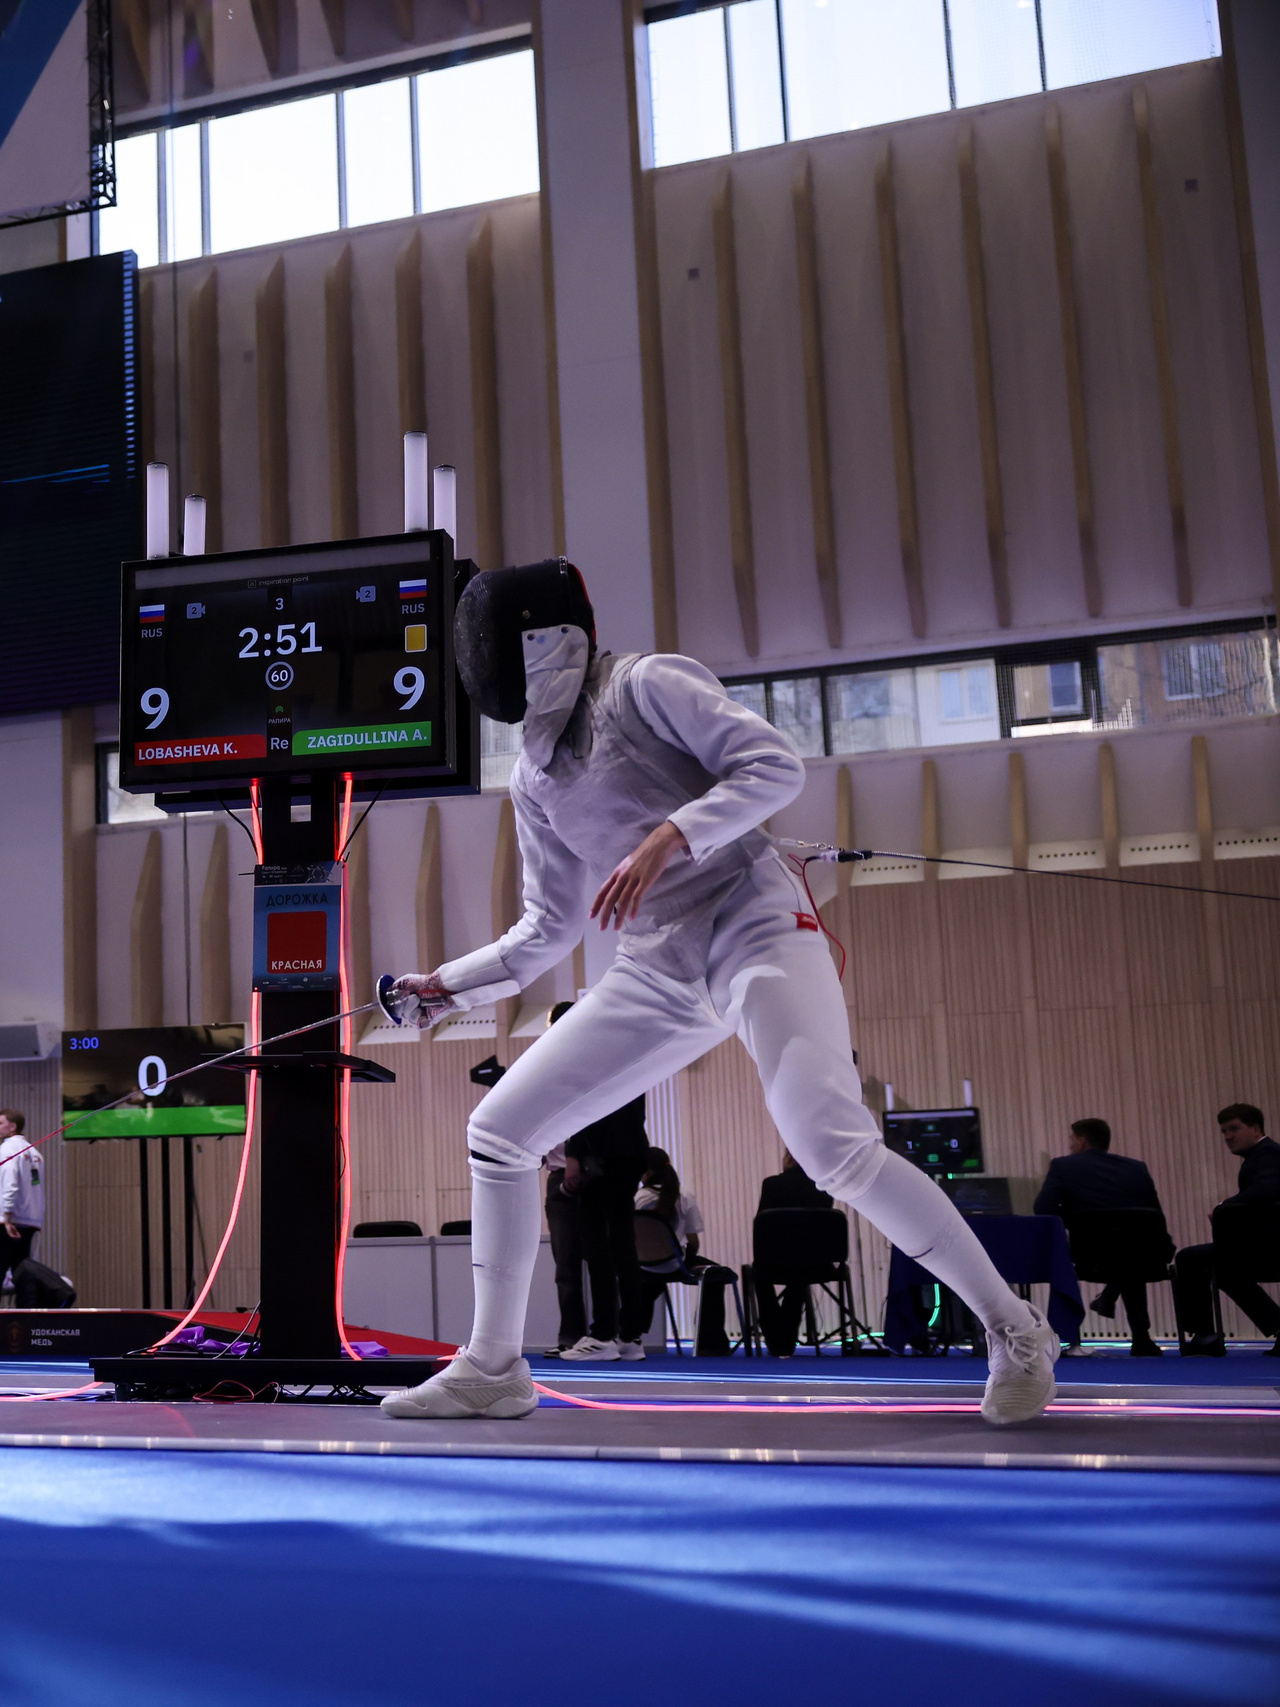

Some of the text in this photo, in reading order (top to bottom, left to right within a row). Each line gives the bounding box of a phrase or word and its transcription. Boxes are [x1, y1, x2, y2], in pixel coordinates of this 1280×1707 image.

[275, 597, 284, 610] 3
[401, 603, 425, 614] RUS
[141, 628, 163, 638] RUS
[238, 621, 323, 659] 2:51
[271, 669, 288, 683] 60
[393, 666, 426, 711] 9
[140, 687, 170, 730] 9
[270, 737, 289, 750] Re
[307, 729, 428, 749] ZAGIDULLINA A.
[138, 742, 238, 760] LOBASHEVA K.
[266, 892, 328, 907] ДОРОЖКА
[271, 959, 322, 970] КРАСНАЯ
[70, 1037, 99, 1050] 3:00
[137, 1055, 168, 1097] 0
[30, 1328, 81, 1337] УДОКАНСКАЯ
[30, 1338, 53, 1347] МЕДЬ
